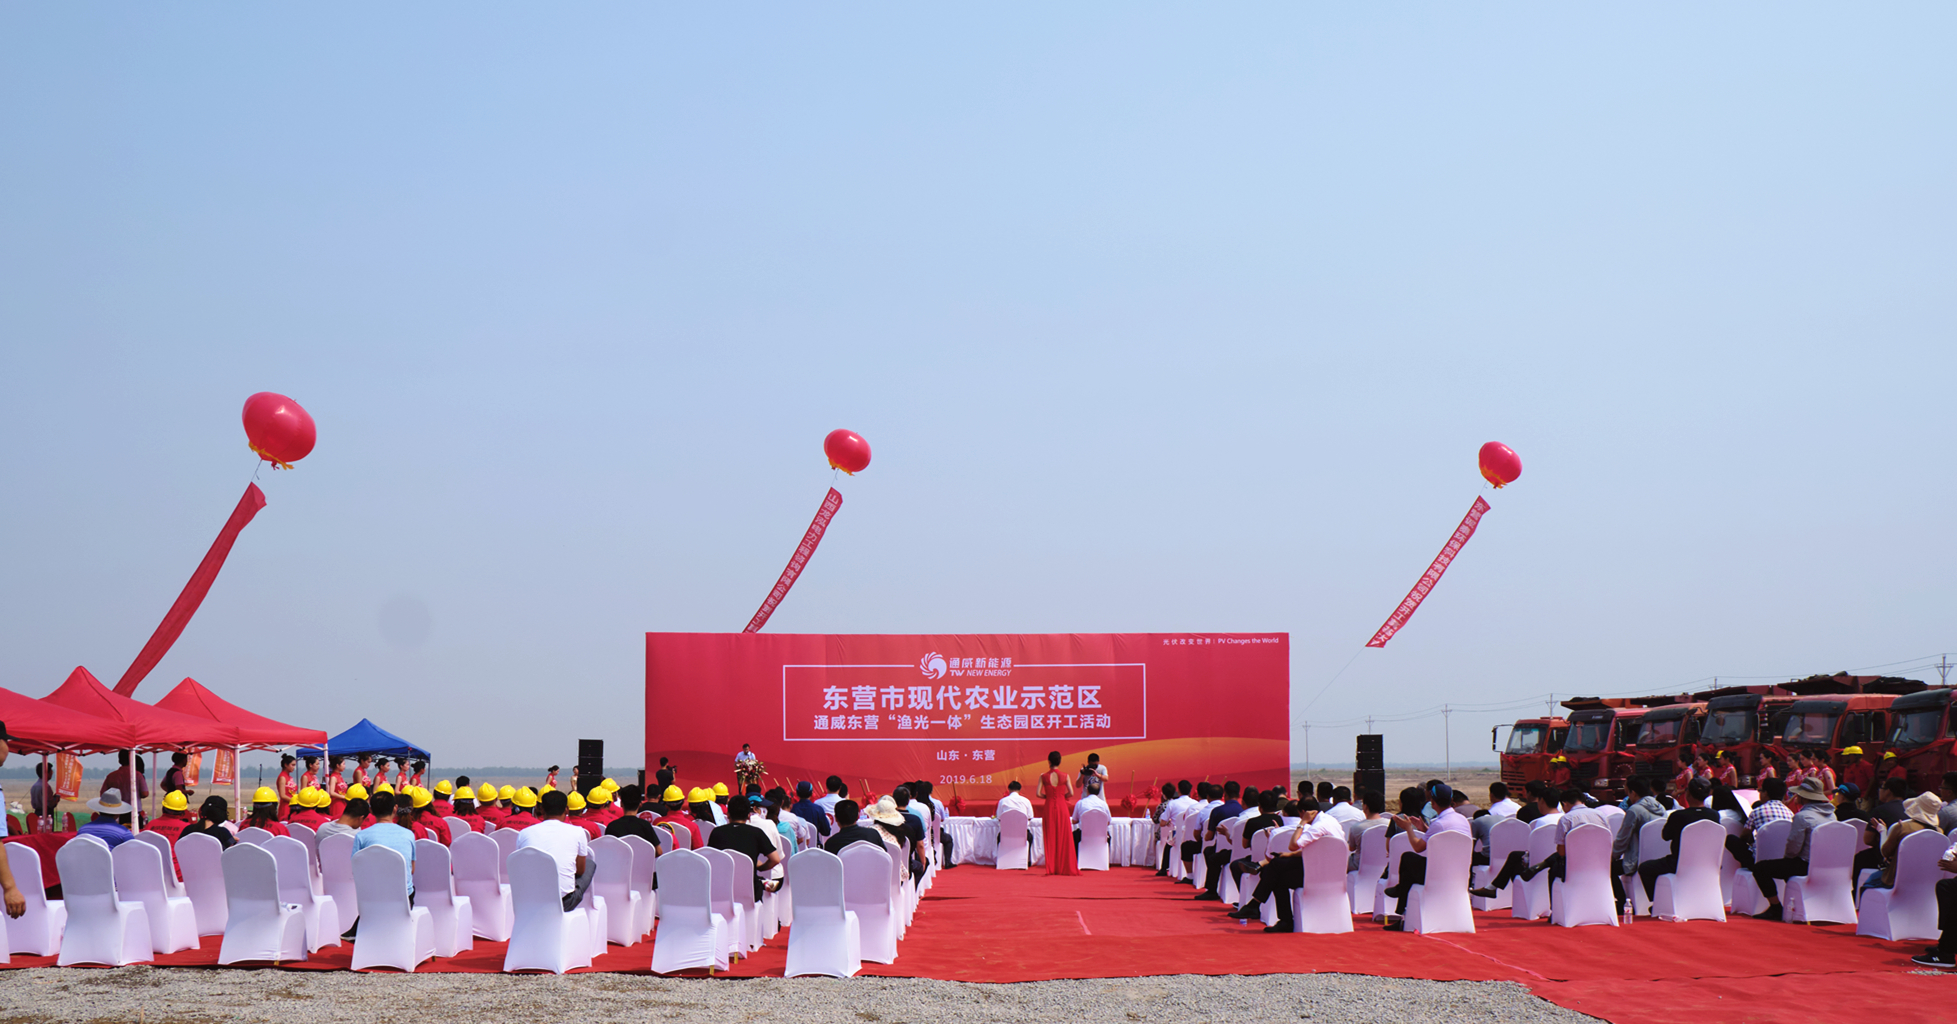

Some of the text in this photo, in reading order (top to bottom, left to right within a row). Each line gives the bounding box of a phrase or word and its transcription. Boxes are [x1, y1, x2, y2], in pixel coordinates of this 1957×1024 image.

[1163, 638, 1211, 646] 光伏改变世界
[1226, 637, 1251, 646] Changes
[1261, 636, 1279, 644] World
[949, 657, 1012, 669] 通威新能源
[950, 669, 1012, 677] TW NEW ENERGY
[823, 685, 1102, 711] 东营市现代农业示范区
[939, 774, 993, 785] 2019.6.18
